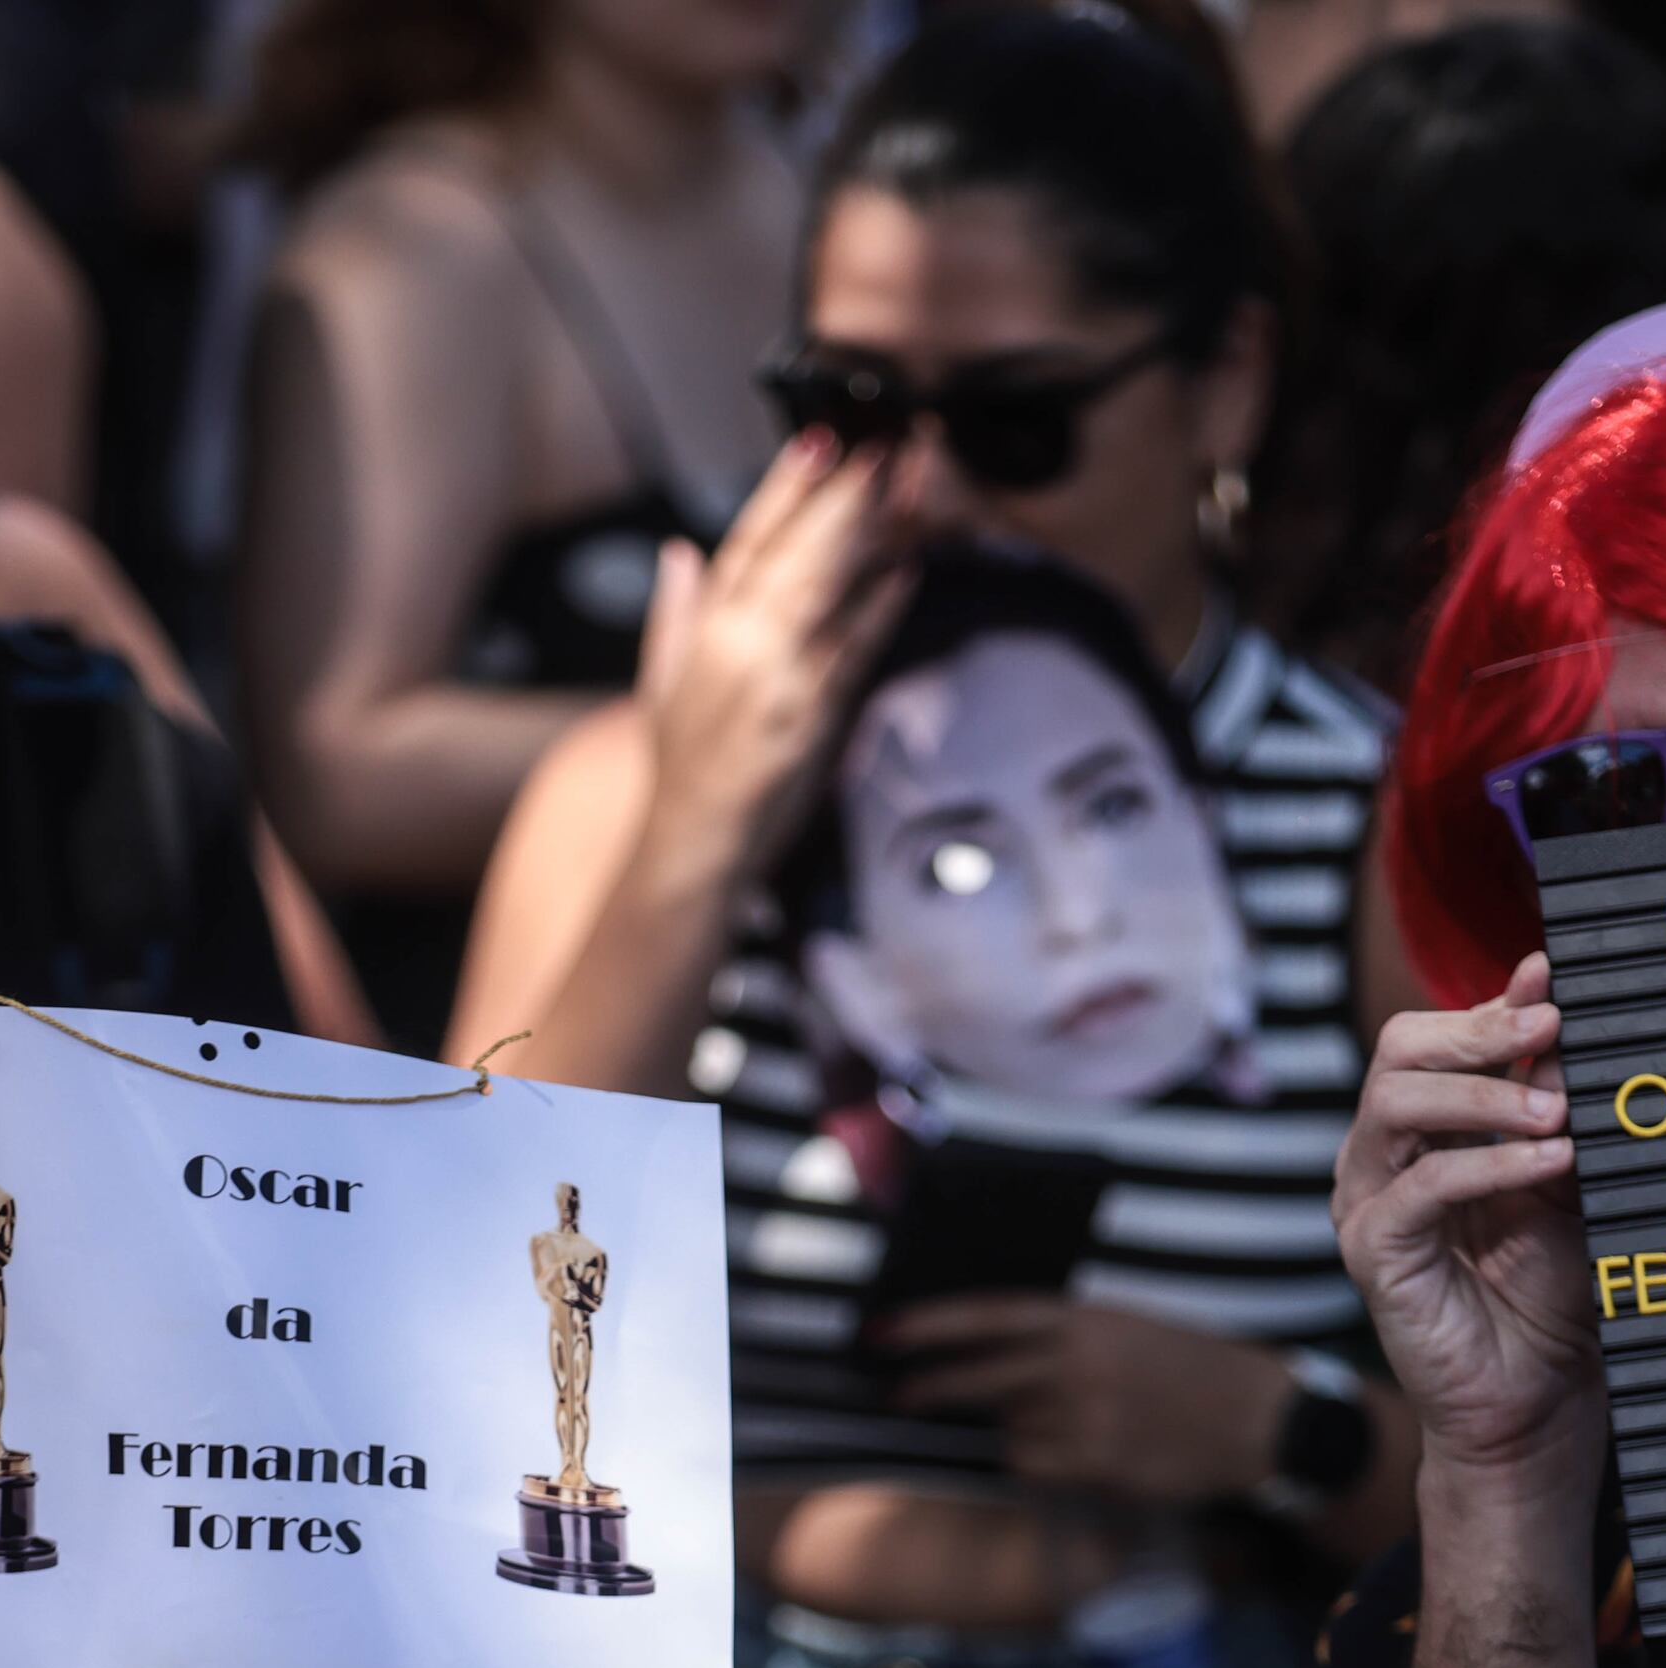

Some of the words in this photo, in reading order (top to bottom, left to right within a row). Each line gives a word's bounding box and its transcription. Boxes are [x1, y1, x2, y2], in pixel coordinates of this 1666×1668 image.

[183, 1153, 364, 1213] Oscar
[225, 1297, 312, 1343] da
[107, 1431, 427, 1490] Fernanda
[162, 1504, 362, 1555] Torres
